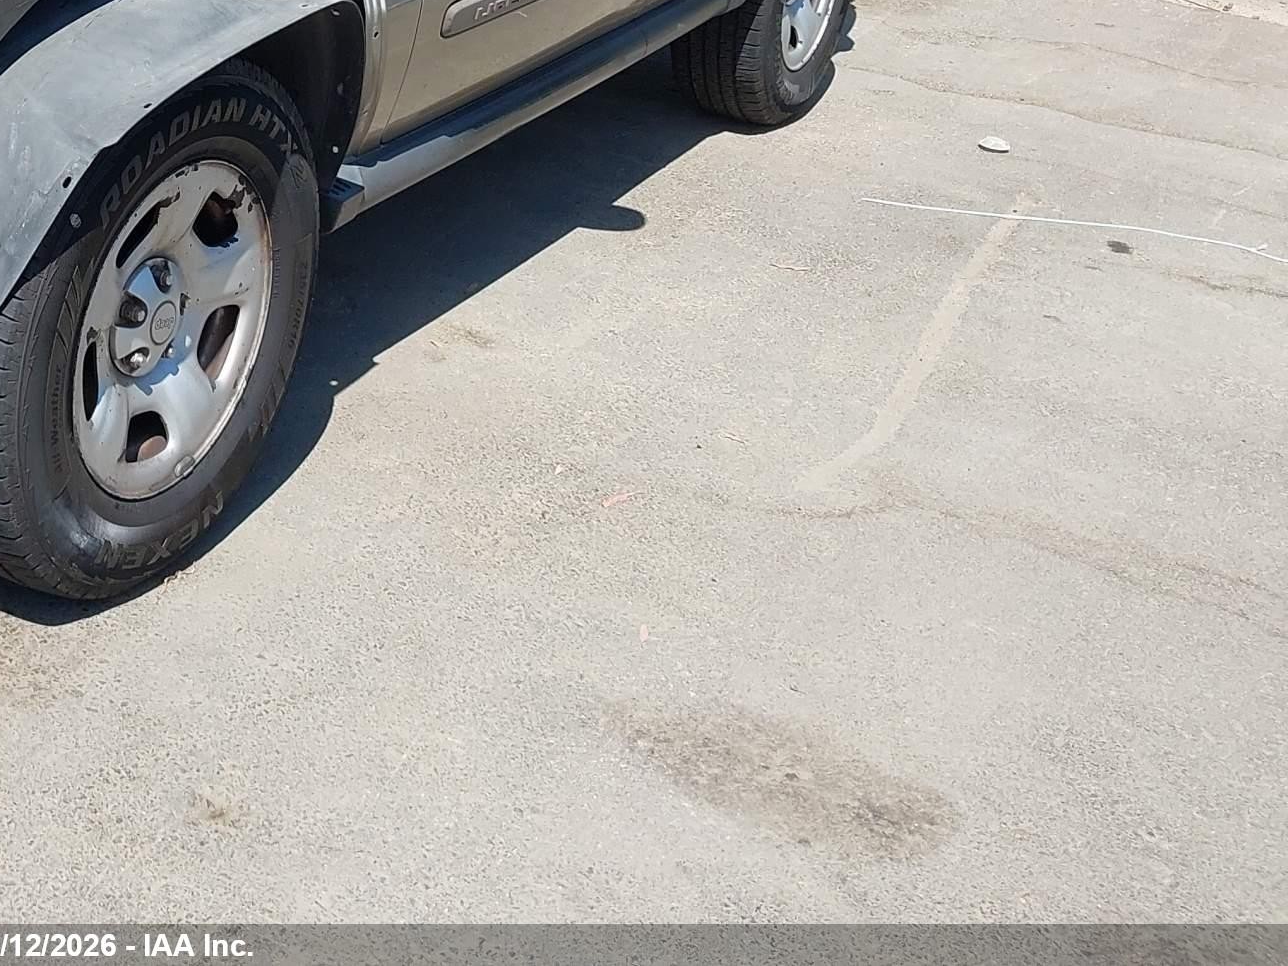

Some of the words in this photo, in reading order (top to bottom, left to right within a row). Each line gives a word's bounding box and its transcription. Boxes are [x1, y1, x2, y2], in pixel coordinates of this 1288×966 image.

[98, 96, 248, 232] ROADIAN
[248, 103, 299, 155] HTX
[94, 490, 225, 570] NEXEN
